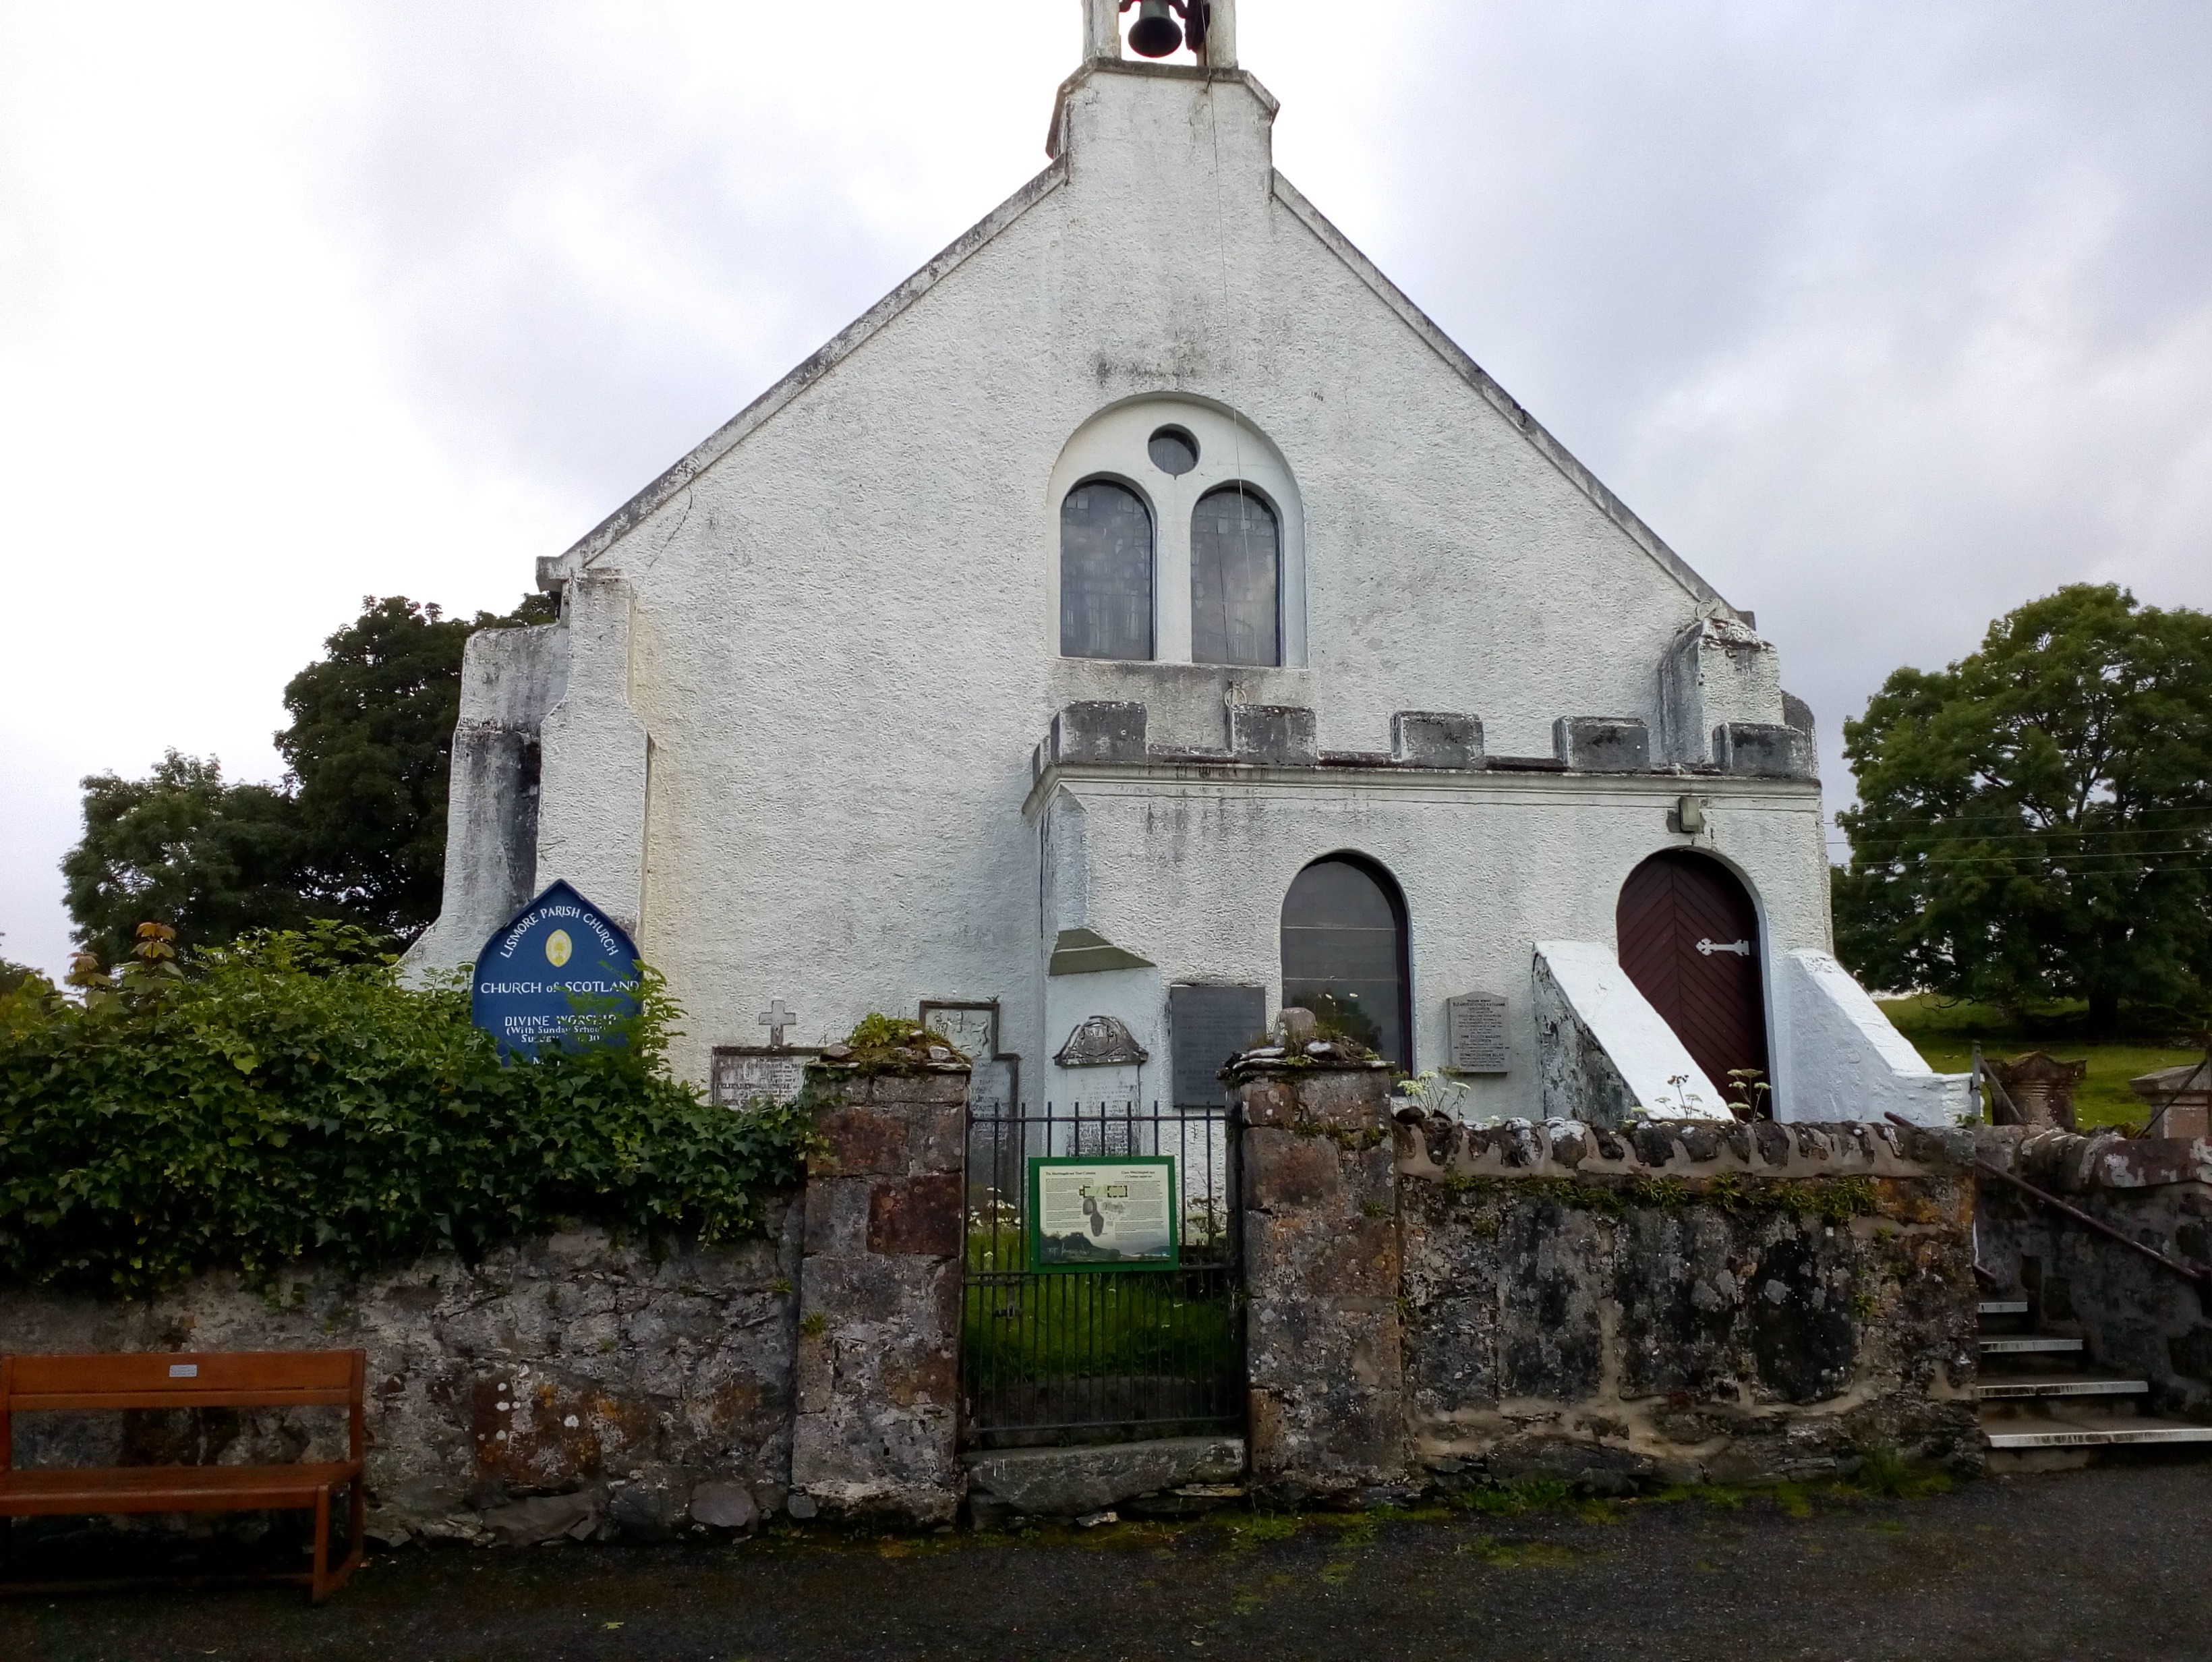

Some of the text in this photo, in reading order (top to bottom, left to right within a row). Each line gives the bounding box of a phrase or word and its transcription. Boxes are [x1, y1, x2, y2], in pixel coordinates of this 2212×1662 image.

[500, 906, 619, 958] LISMORE PARISH CHURCH
[481, 982, 541, 994] CHURCH
[564, 980, 639, 993] SCOTLAND
[504, 1016, 550, 1026] DIVINE
[506, 1026, 534, 1035] (With
